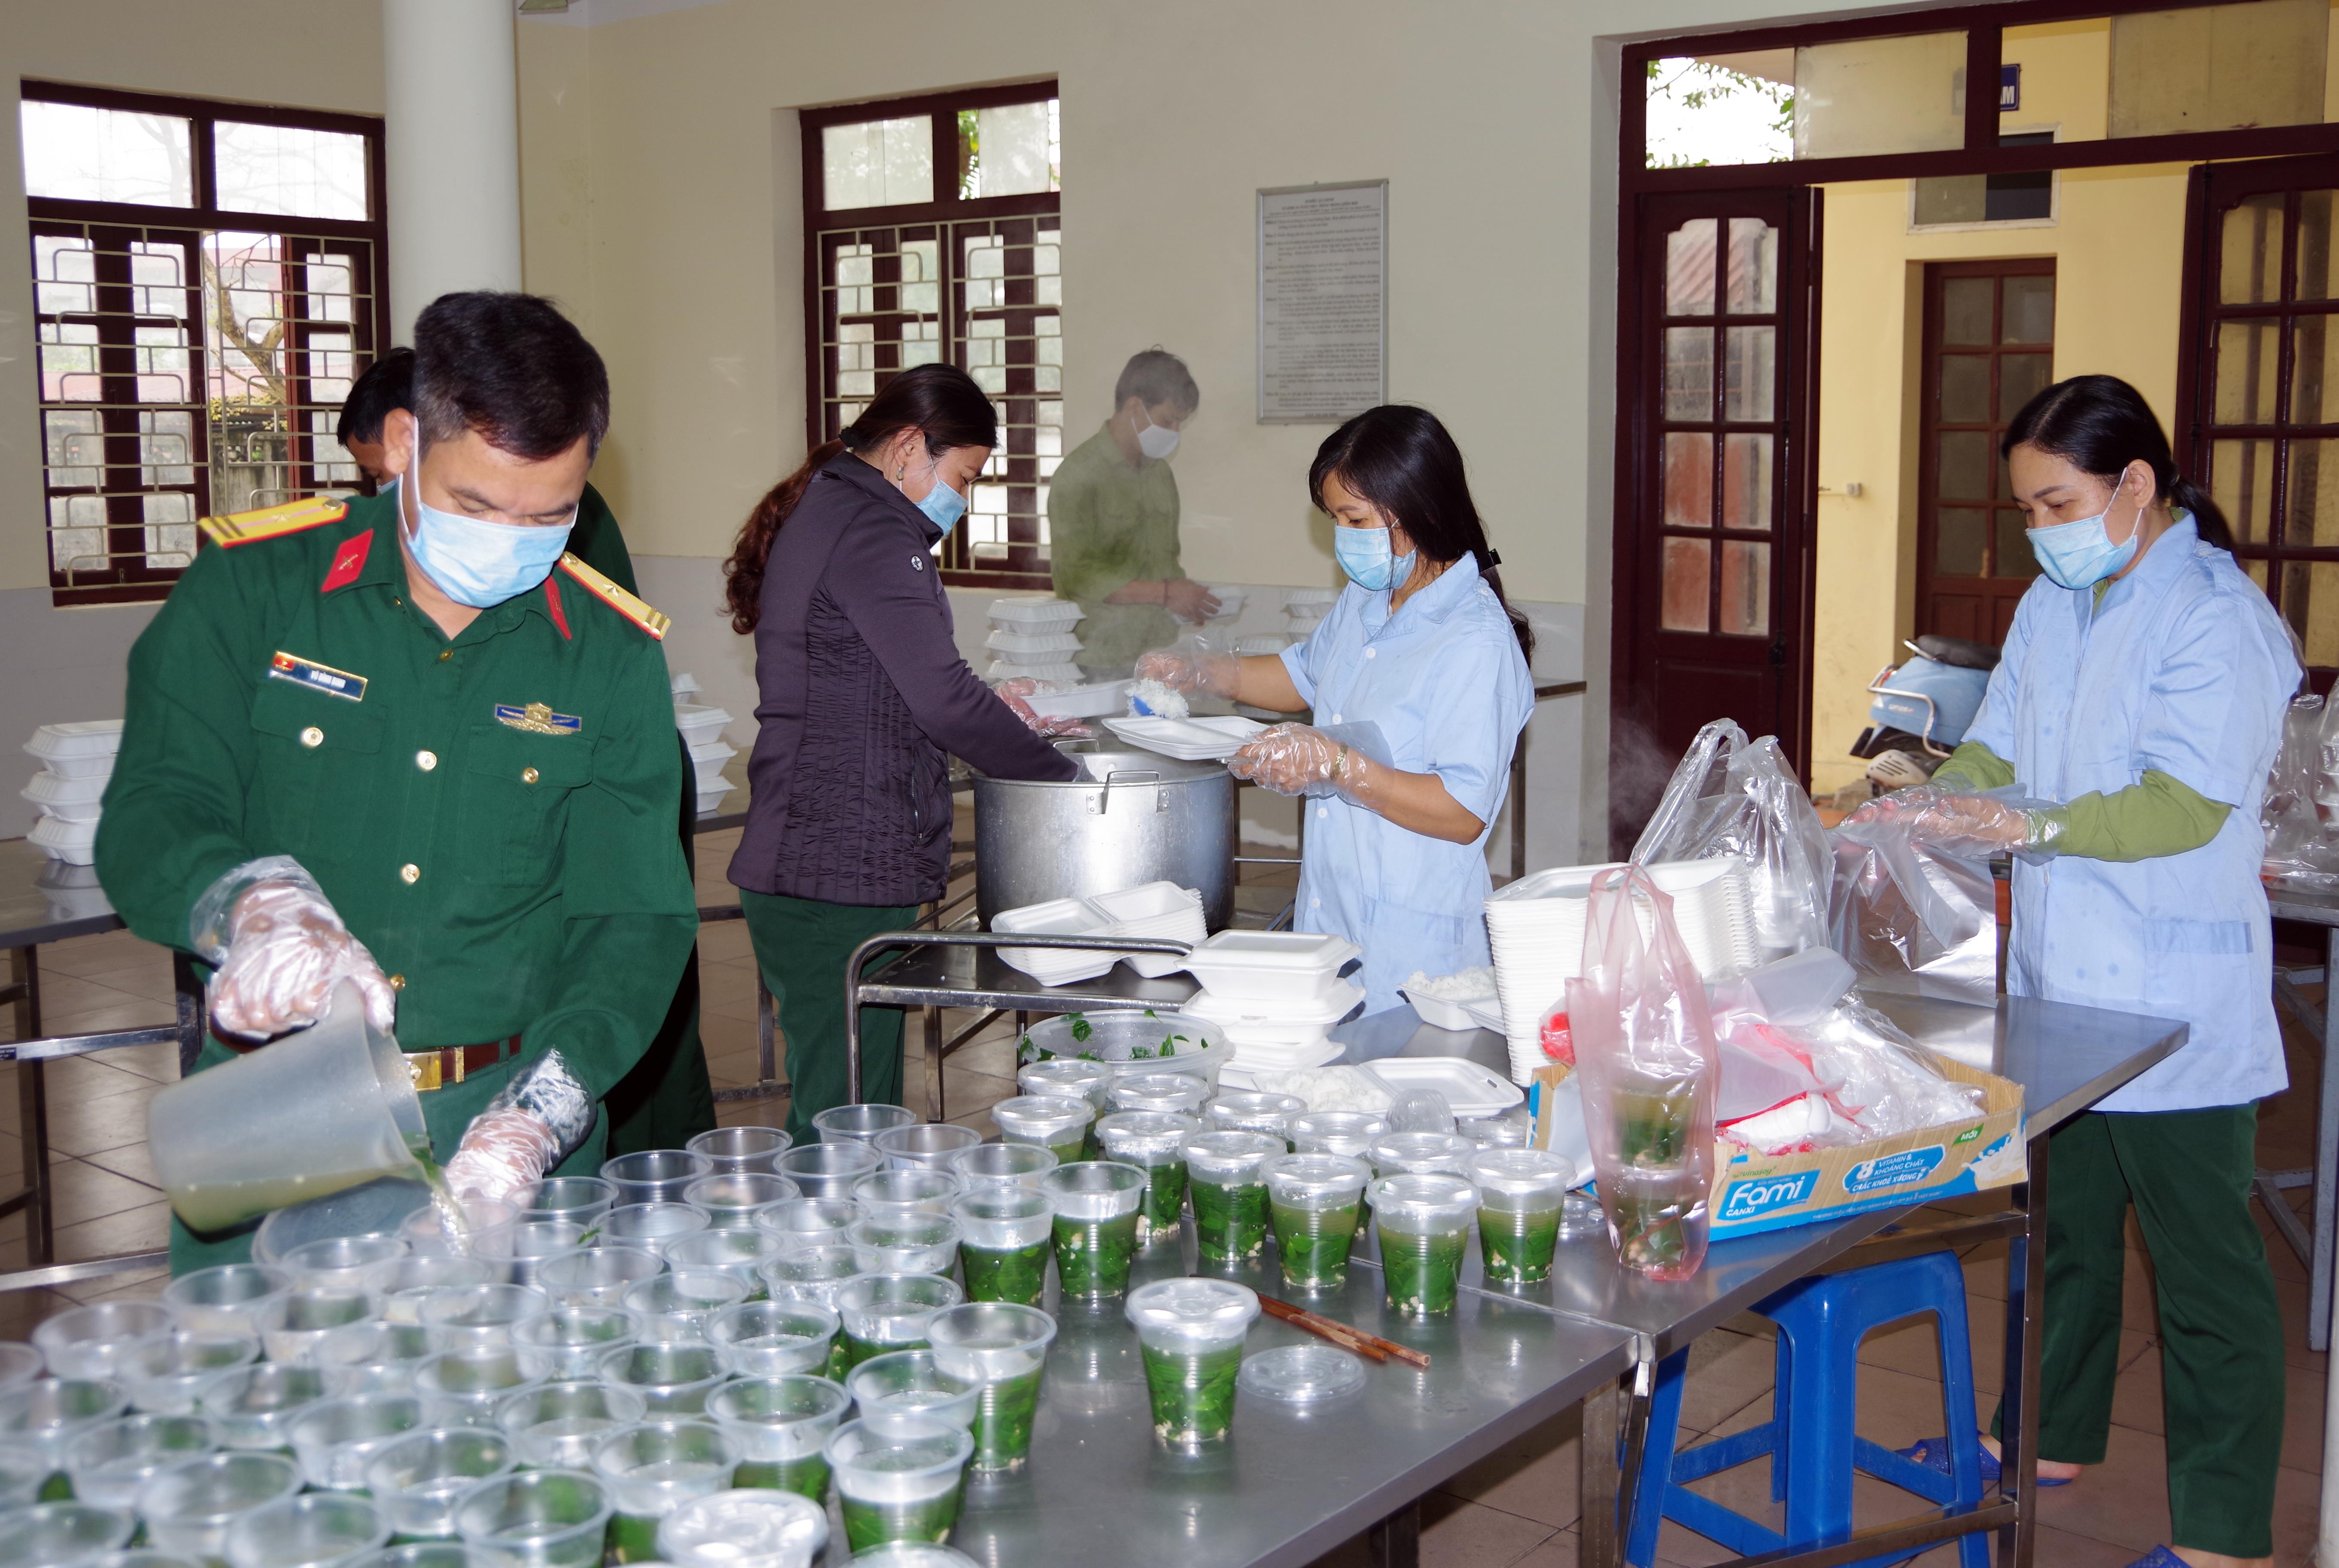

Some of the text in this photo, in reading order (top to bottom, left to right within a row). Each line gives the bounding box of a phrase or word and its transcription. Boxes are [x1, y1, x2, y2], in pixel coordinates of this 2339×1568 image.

[2001, 85, 2015, 105] M
[1960, 1130, 1978, 1140] MỚI
[1879, 1155, 1907, 1168] VITAMIN
[1856, 1159, 1876, 1180] 8
[1874, 1164, 1903, 1176] KHOÁNG
[1729, 1176, 1805, 1208] Fami
[1726, 1206, 1755, 1216] CANXI
